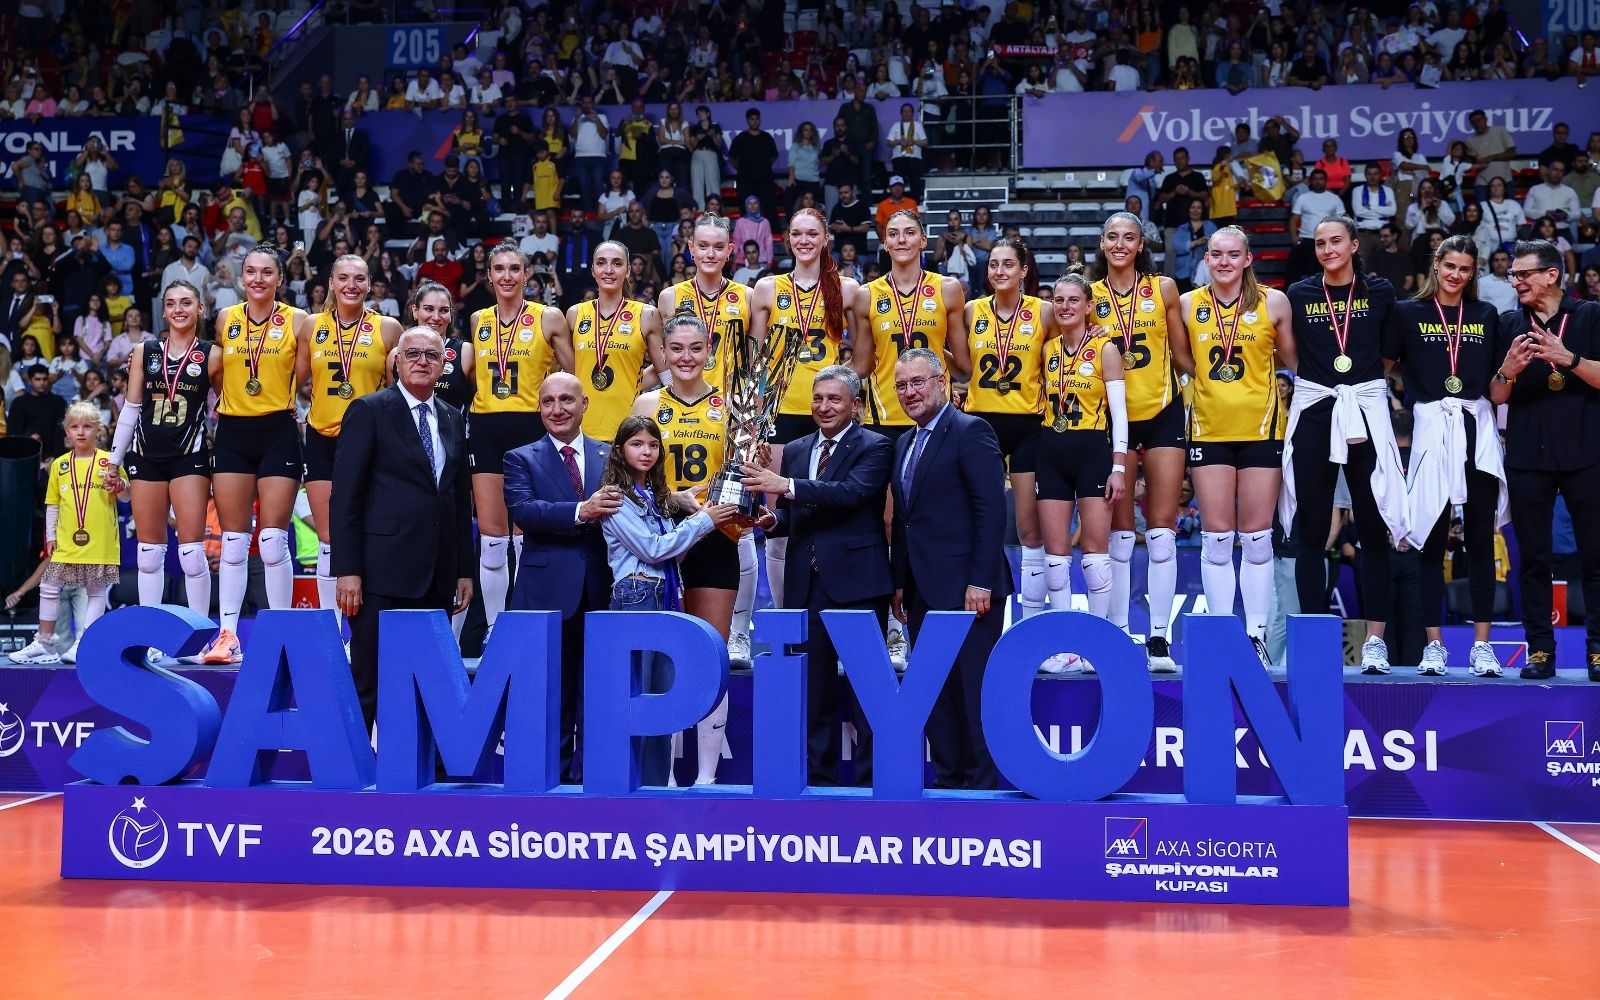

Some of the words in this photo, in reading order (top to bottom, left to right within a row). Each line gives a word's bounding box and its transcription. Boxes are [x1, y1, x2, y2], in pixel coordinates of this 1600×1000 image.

[393, 28, 440, 65] 205
[1305, 299, 1369, 315] VAKFBNK
[1418, 322, 1484, 336] VAKFANK
[979, 353, 1022, 391] 22
[1209, 346, 1245, 380] 25
[488, 361, 518, 395] 11
[152, 393, 188, 427] 10
[1049, 393, 1083, 426] 14
[673, 430, 721, 442] VakıfBank
[669, 444, 708, 482] 18
[1190, 448, 1203, 461] 25
[31, 721, 95, 748] TVF
[1546, 739, 1577, 753] AXA
[177, 822, 263, 857] TVF
[311, 826, 395, 856] 2026
[403, 829, 480, 857] AXA
[488, 823, 637, 860] SİGORTA
[645, 825, 903, 866] ŞAMPİYONLAR
[912, 837, 1042, 869] KUPASI
[1105, 838, 1140, 855] AXA
[1155, 840, 1191, 857] AXA
[1196, 838, 1278, 859] SİGORTA
[1105, 862, 1279, 878] ŞAMPİYONLAR
[1155, 880, 1228, 893] KUPASI
